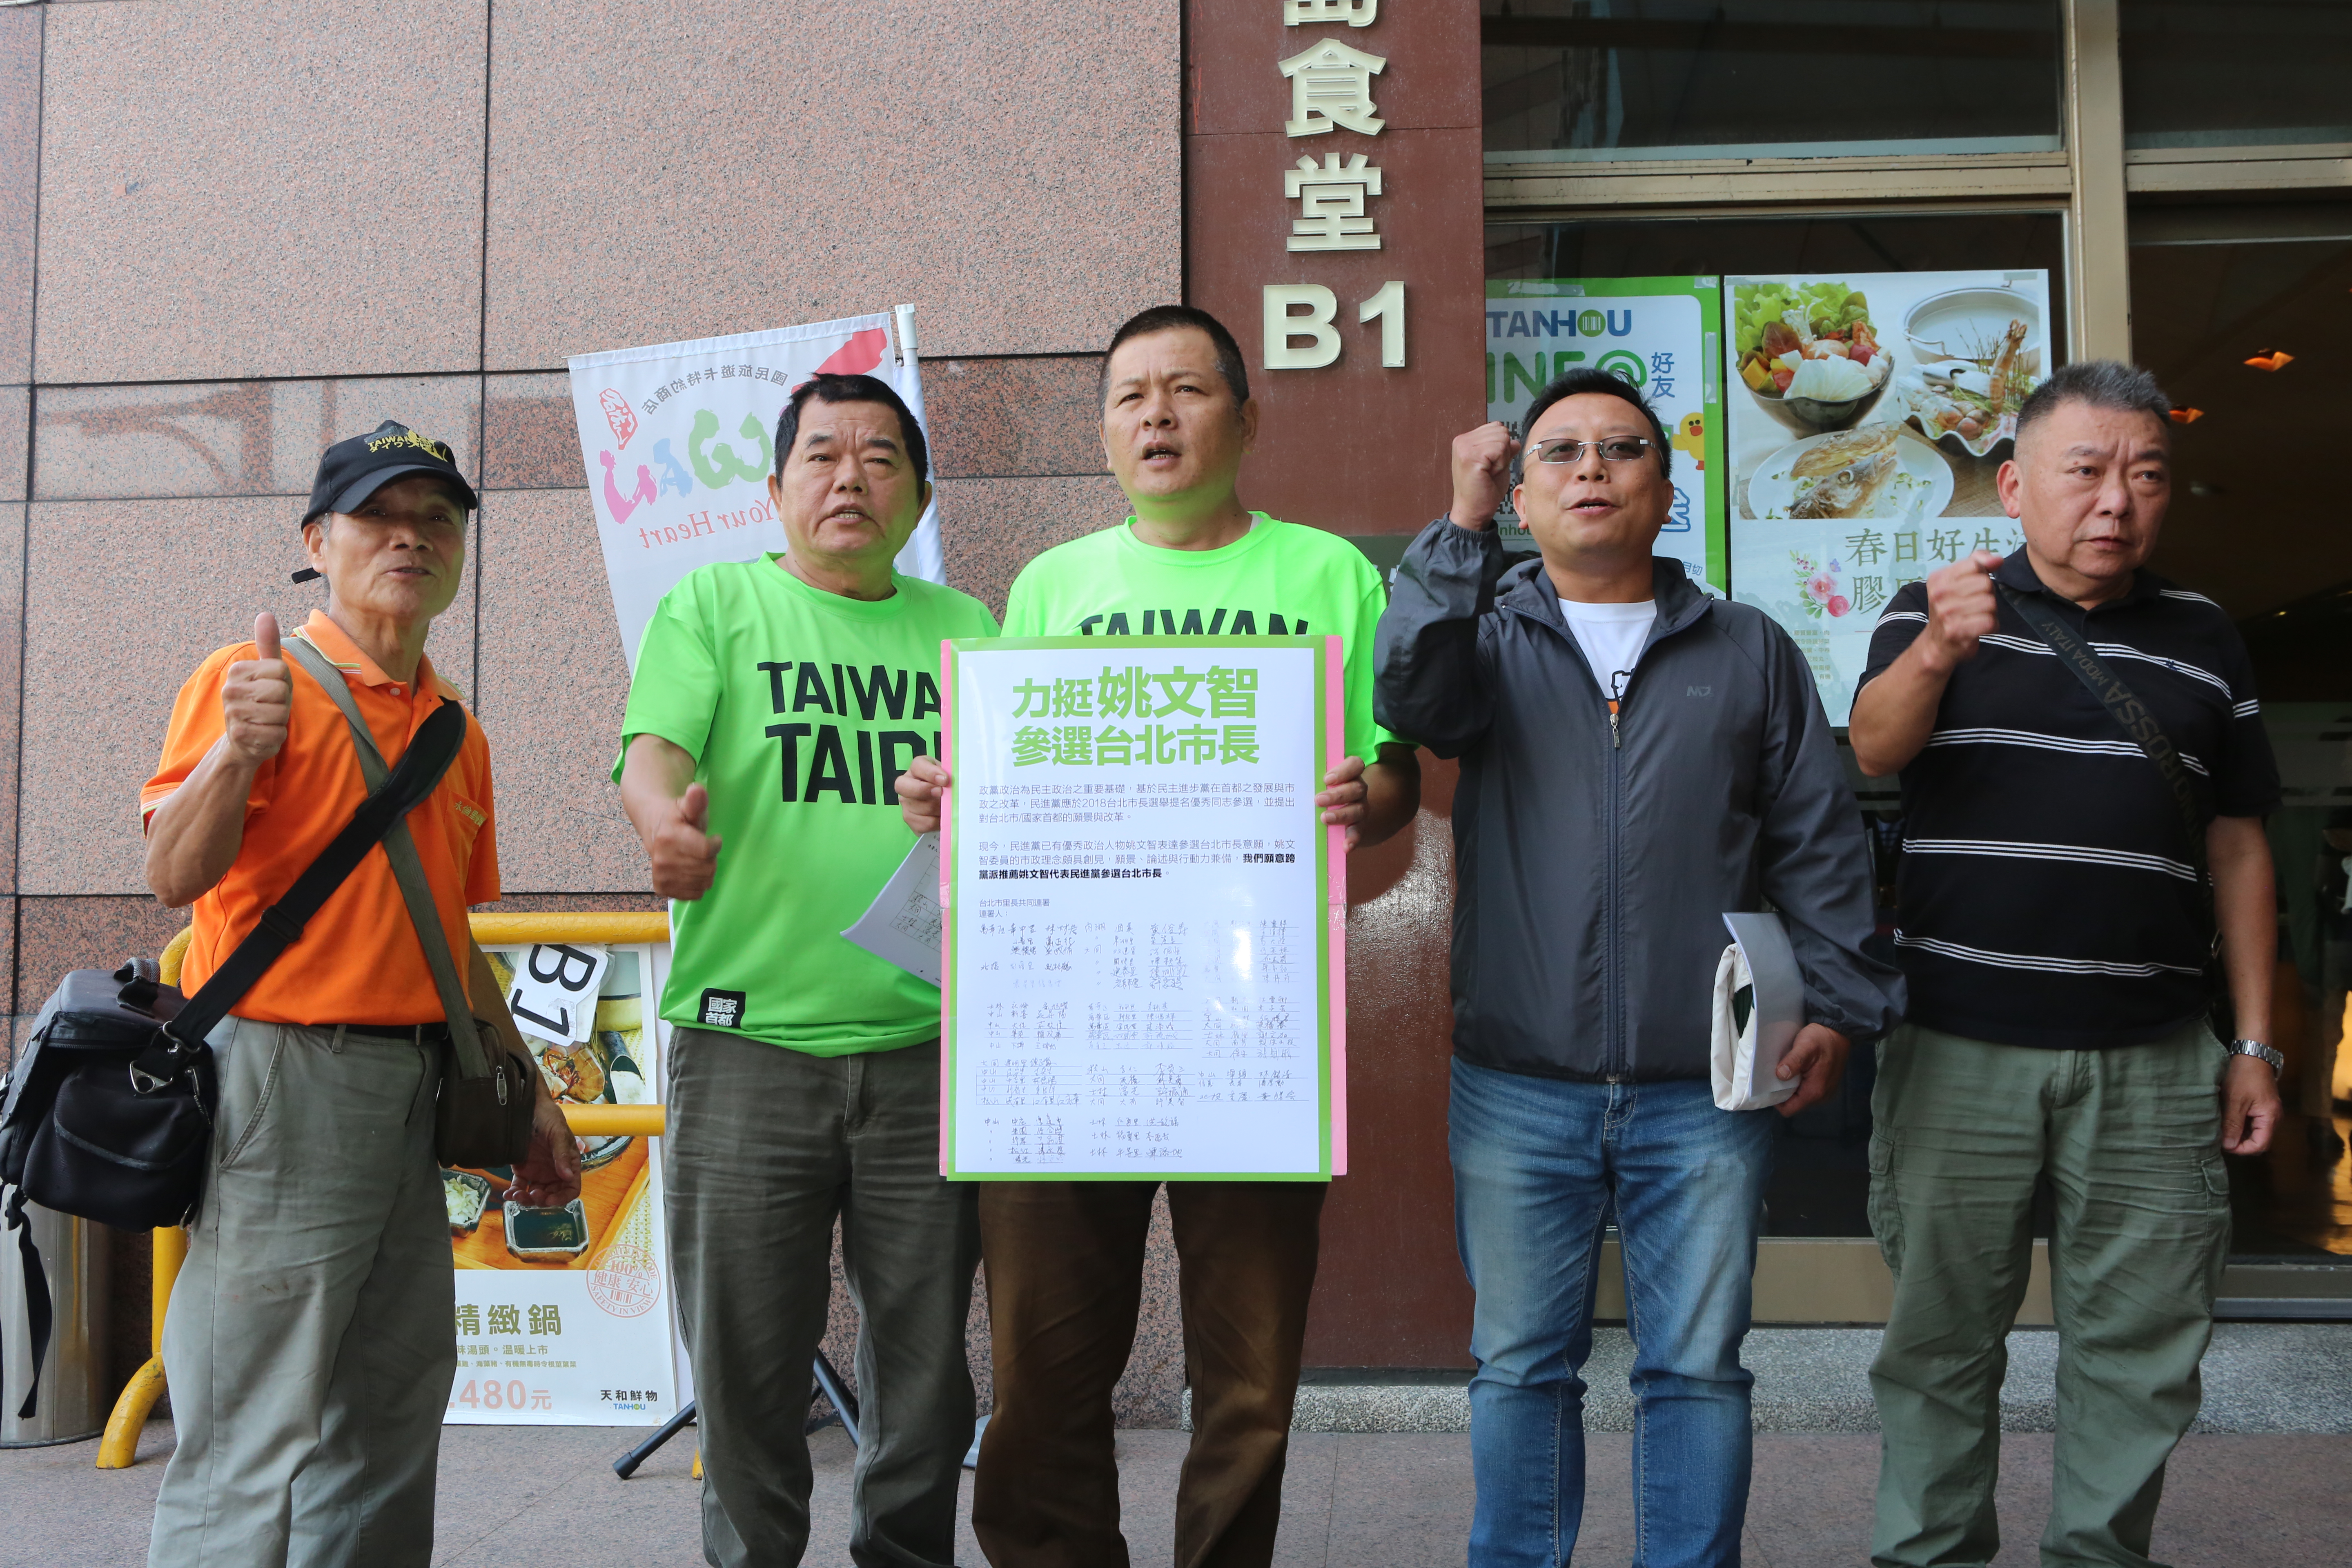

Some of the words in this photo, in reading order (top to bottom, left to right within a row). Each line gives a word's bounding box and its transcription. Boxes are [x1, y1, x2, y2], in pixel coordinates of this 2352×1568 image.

[1263, 281, 1405, 370] B1
[1486, 309, 1631, 337] TANHOU
[1651, 352, 1675, 398] 好友
[368, 436, 410, 448] TAIWAN
[1848, 575, 1927, 615] 膠
[2041, 621, 2077, 653] ITALY
[2074, 649, 2109, 686] MODA
[757, 661, 941, 720] TAIWA
[1011, 665, 1259, 719] 力挺姚文智
[1011, 724, 1260, 767] 參選台北市長
[765, 723, 941, 805] TAIP
[979, 783, 1295, 795] 政黨政治為民主政治之重要基礎，基於民主進步黨在首都之發展與市
[979, 797, 1295, 809] 政之改革，民進黨應於2018台北市長選舉提名優秀同志參選，並提出
[979, 812, 1131, 824] 對台北市/國家首都的願景與改革。
[979, 839, 1295, 852] 現今，民進黨已有優秀政治人物姚文智表達參選台北市長意願，姚文
[979, 868, 1169, 880] 黨派推薦姚文智代表民進黨參選台北市長。
[979, 898, 1050, 907] 台北市里長共同連署
[979, 909, 1008, 918] 連署人：
[708, 997, 737, 1013] 國家
[705, 1012, 734, 1027] 首都
[1090, 1075, 1104, 1084] 大同
[1198, 1071, 1216, 1079] 中山
[1090, 1098, 1104, 1106] 大同
[984, 1117, 999, 1126] 中山
[1090, 1147, 1107, 1158] 士林
[610, 1260, 643, 1278] 100%
[642, 1257, 658, 1280] CODE
[594, 1270, 622, 1289] 健康
[626, 1278, 654, 1296] 安心
[591, 1285, 618, 1312] SAFETY
[630, 1297, 652, 1314] VIEW
[455, 1303, 562, 1336] 精緻鍋
[600, 1389, 658, 1402] 天和鮮物
